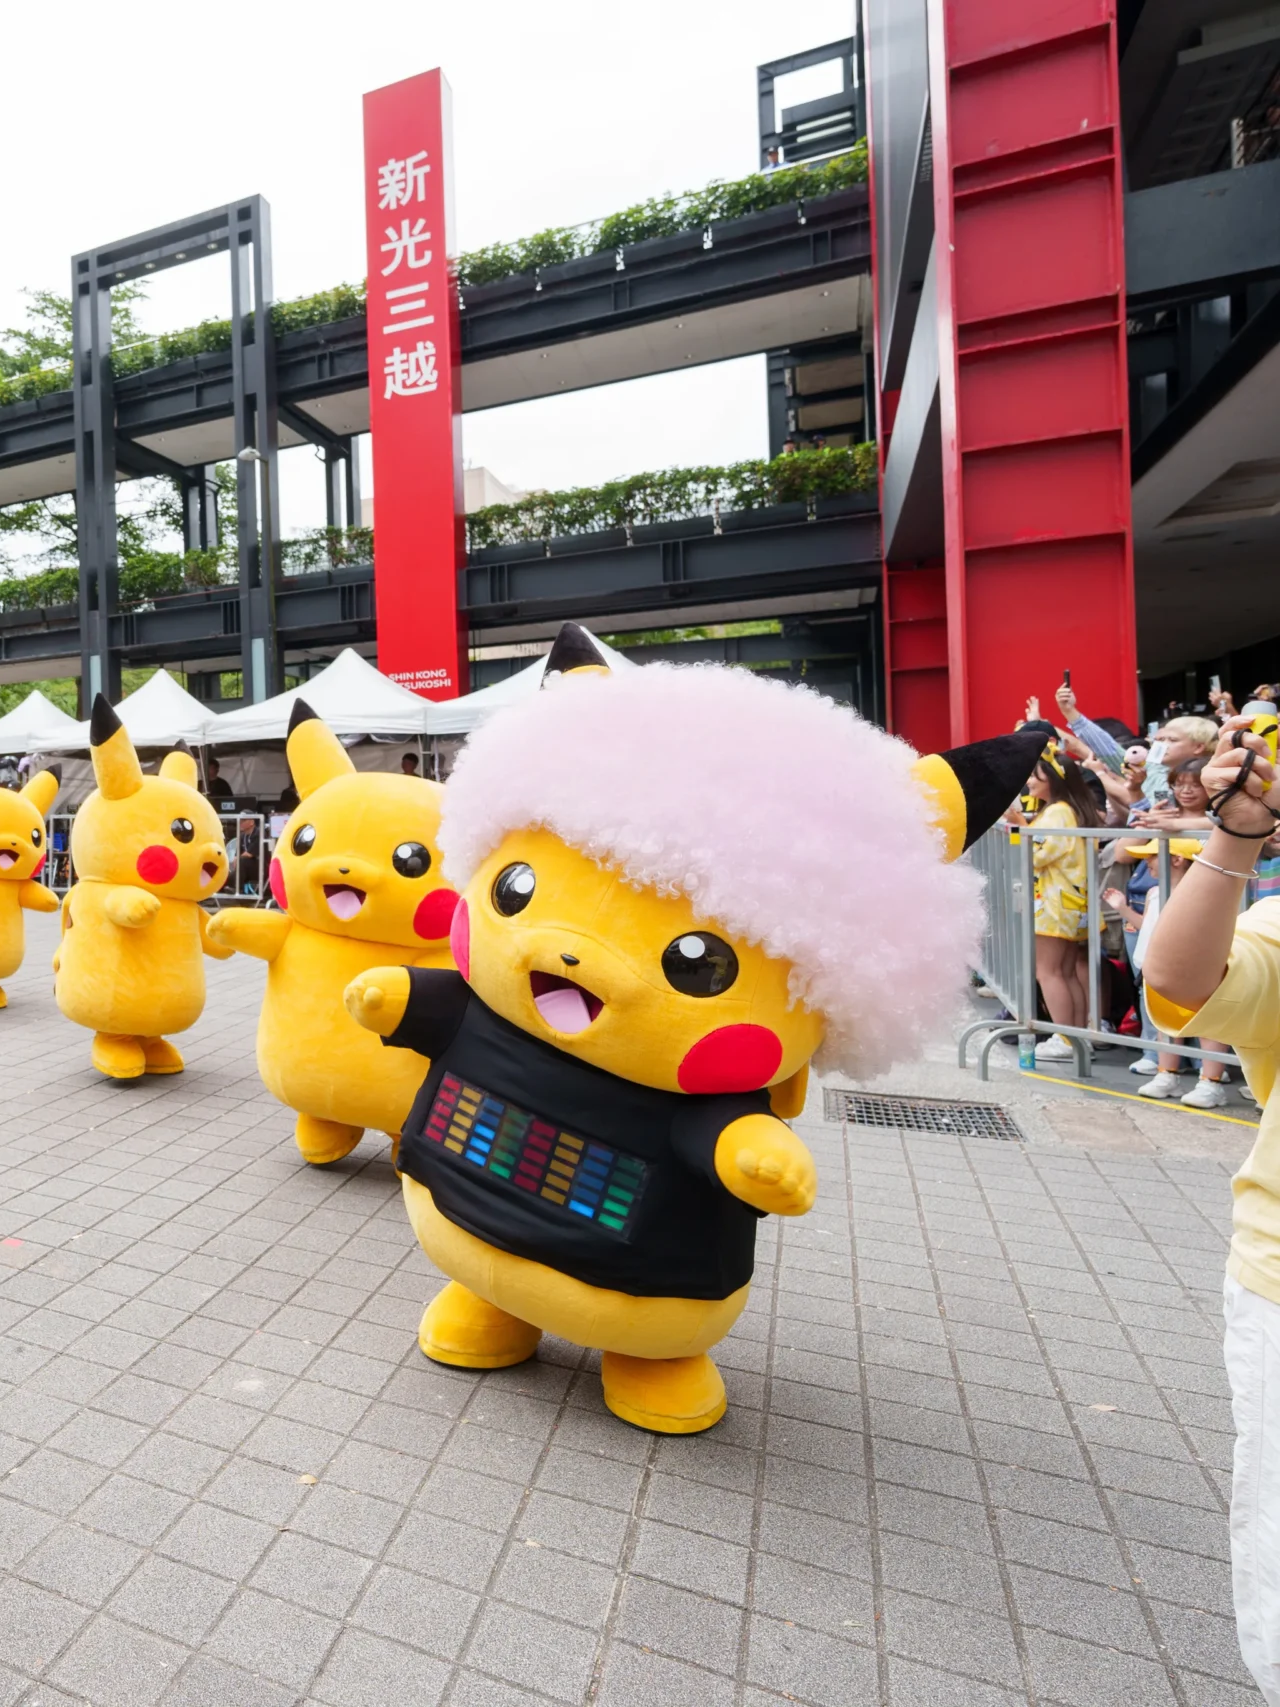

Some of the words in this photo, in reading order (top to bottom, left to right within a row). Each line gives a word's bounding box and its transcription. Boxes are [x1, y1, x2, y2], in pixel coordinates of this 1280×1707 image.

[377, 150, 439, 400] 新光三越
[388, 672, 414, 682] SHIN
[415, 668, 447, 680] KONG
